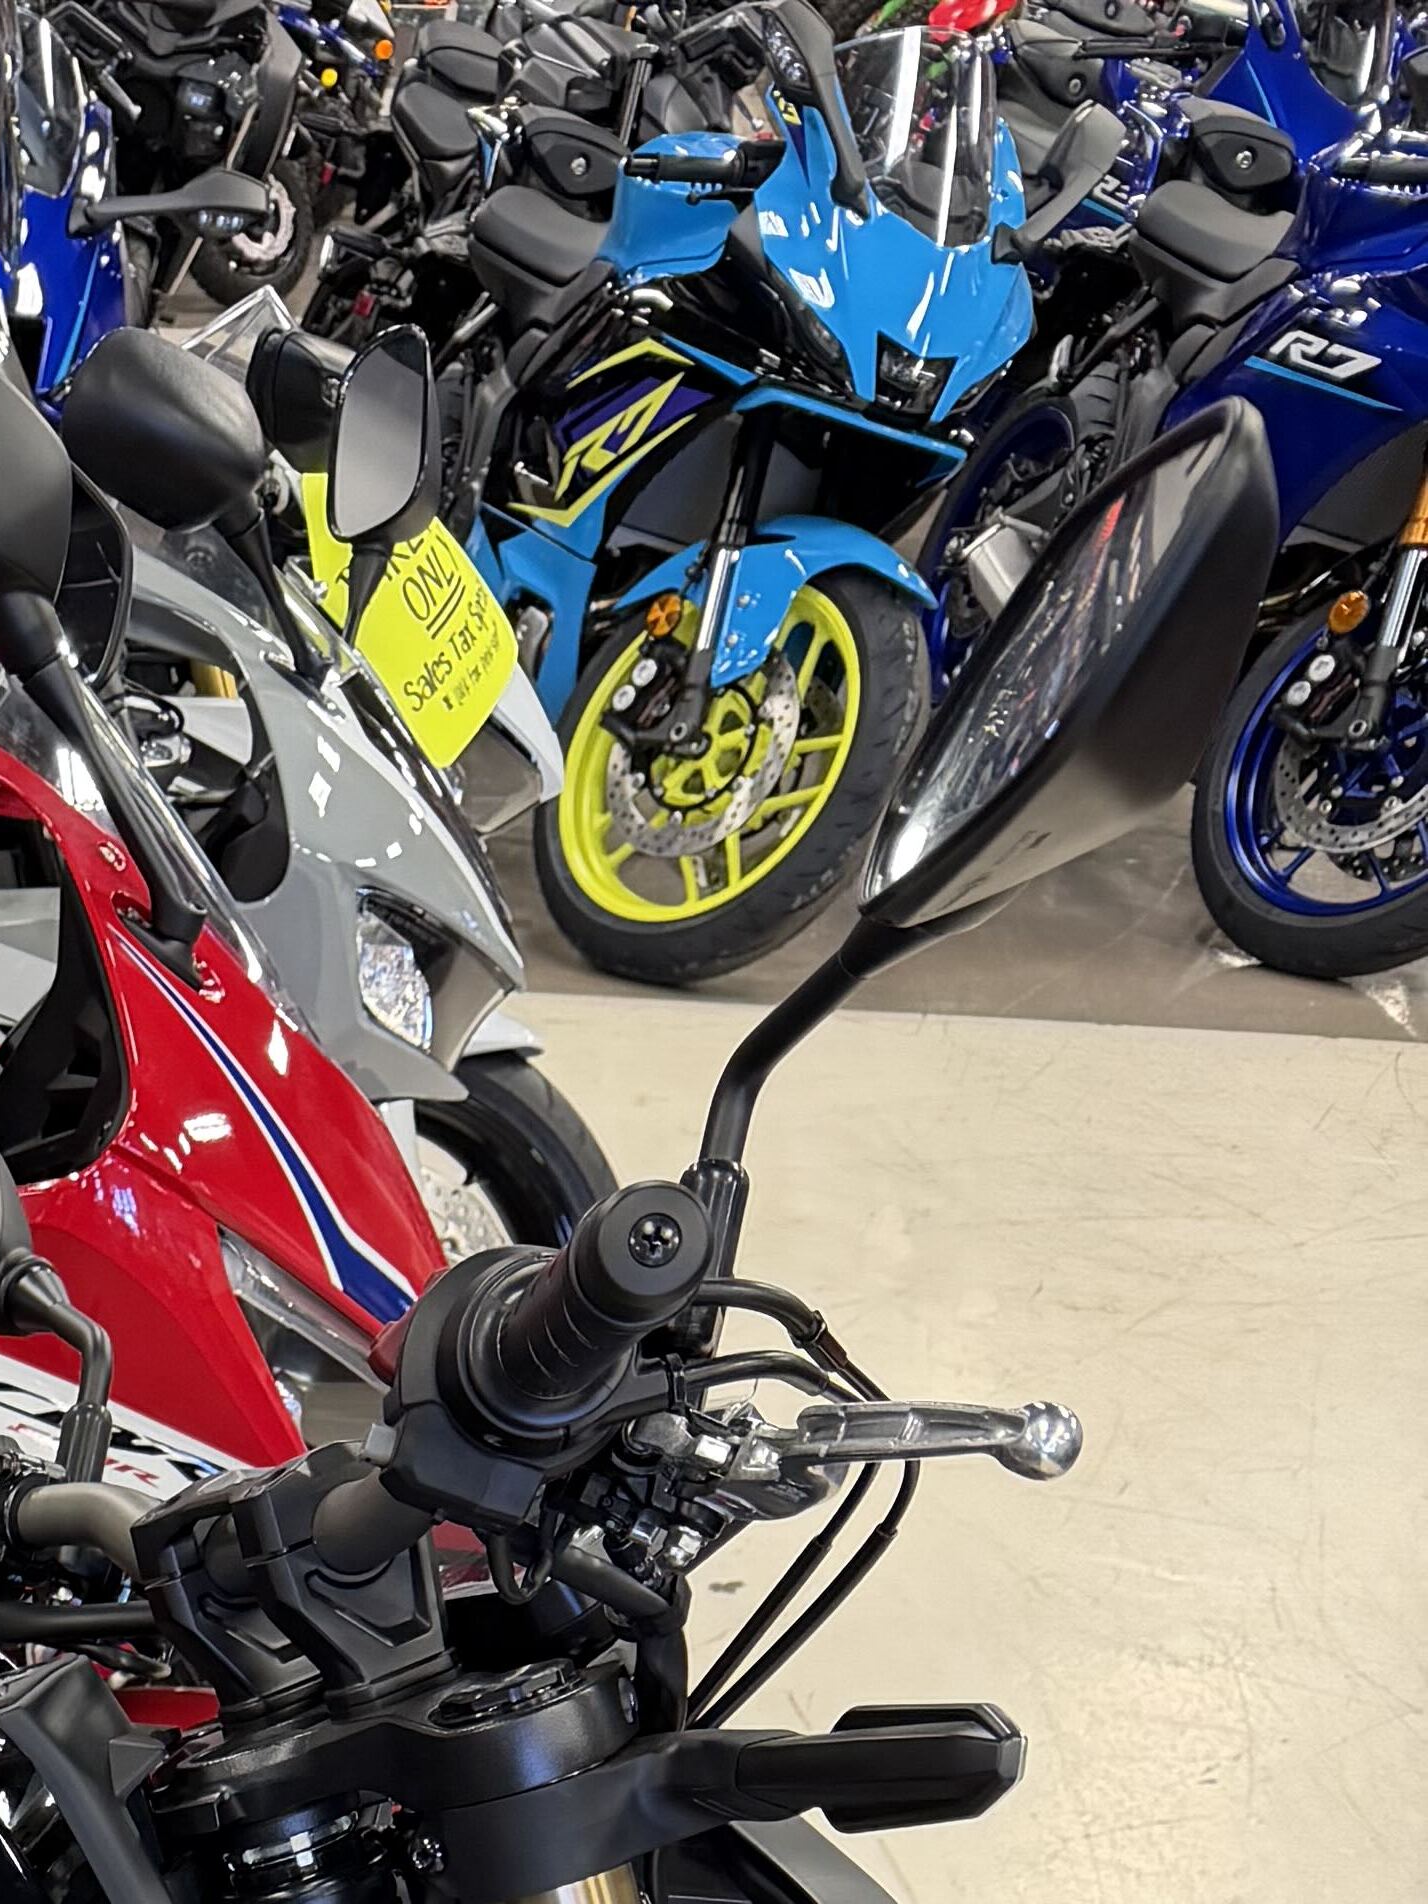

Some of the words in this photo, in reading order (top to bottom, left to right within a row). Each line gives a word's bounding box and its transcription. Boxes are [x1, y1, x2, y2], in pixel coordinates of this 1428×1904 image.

[1269, 329, 1383, 380] R7
[401, 533, 460, 623] ONLY
[403, 651, 454, 714] Sales
[447, 618, 478, 661] Tax
